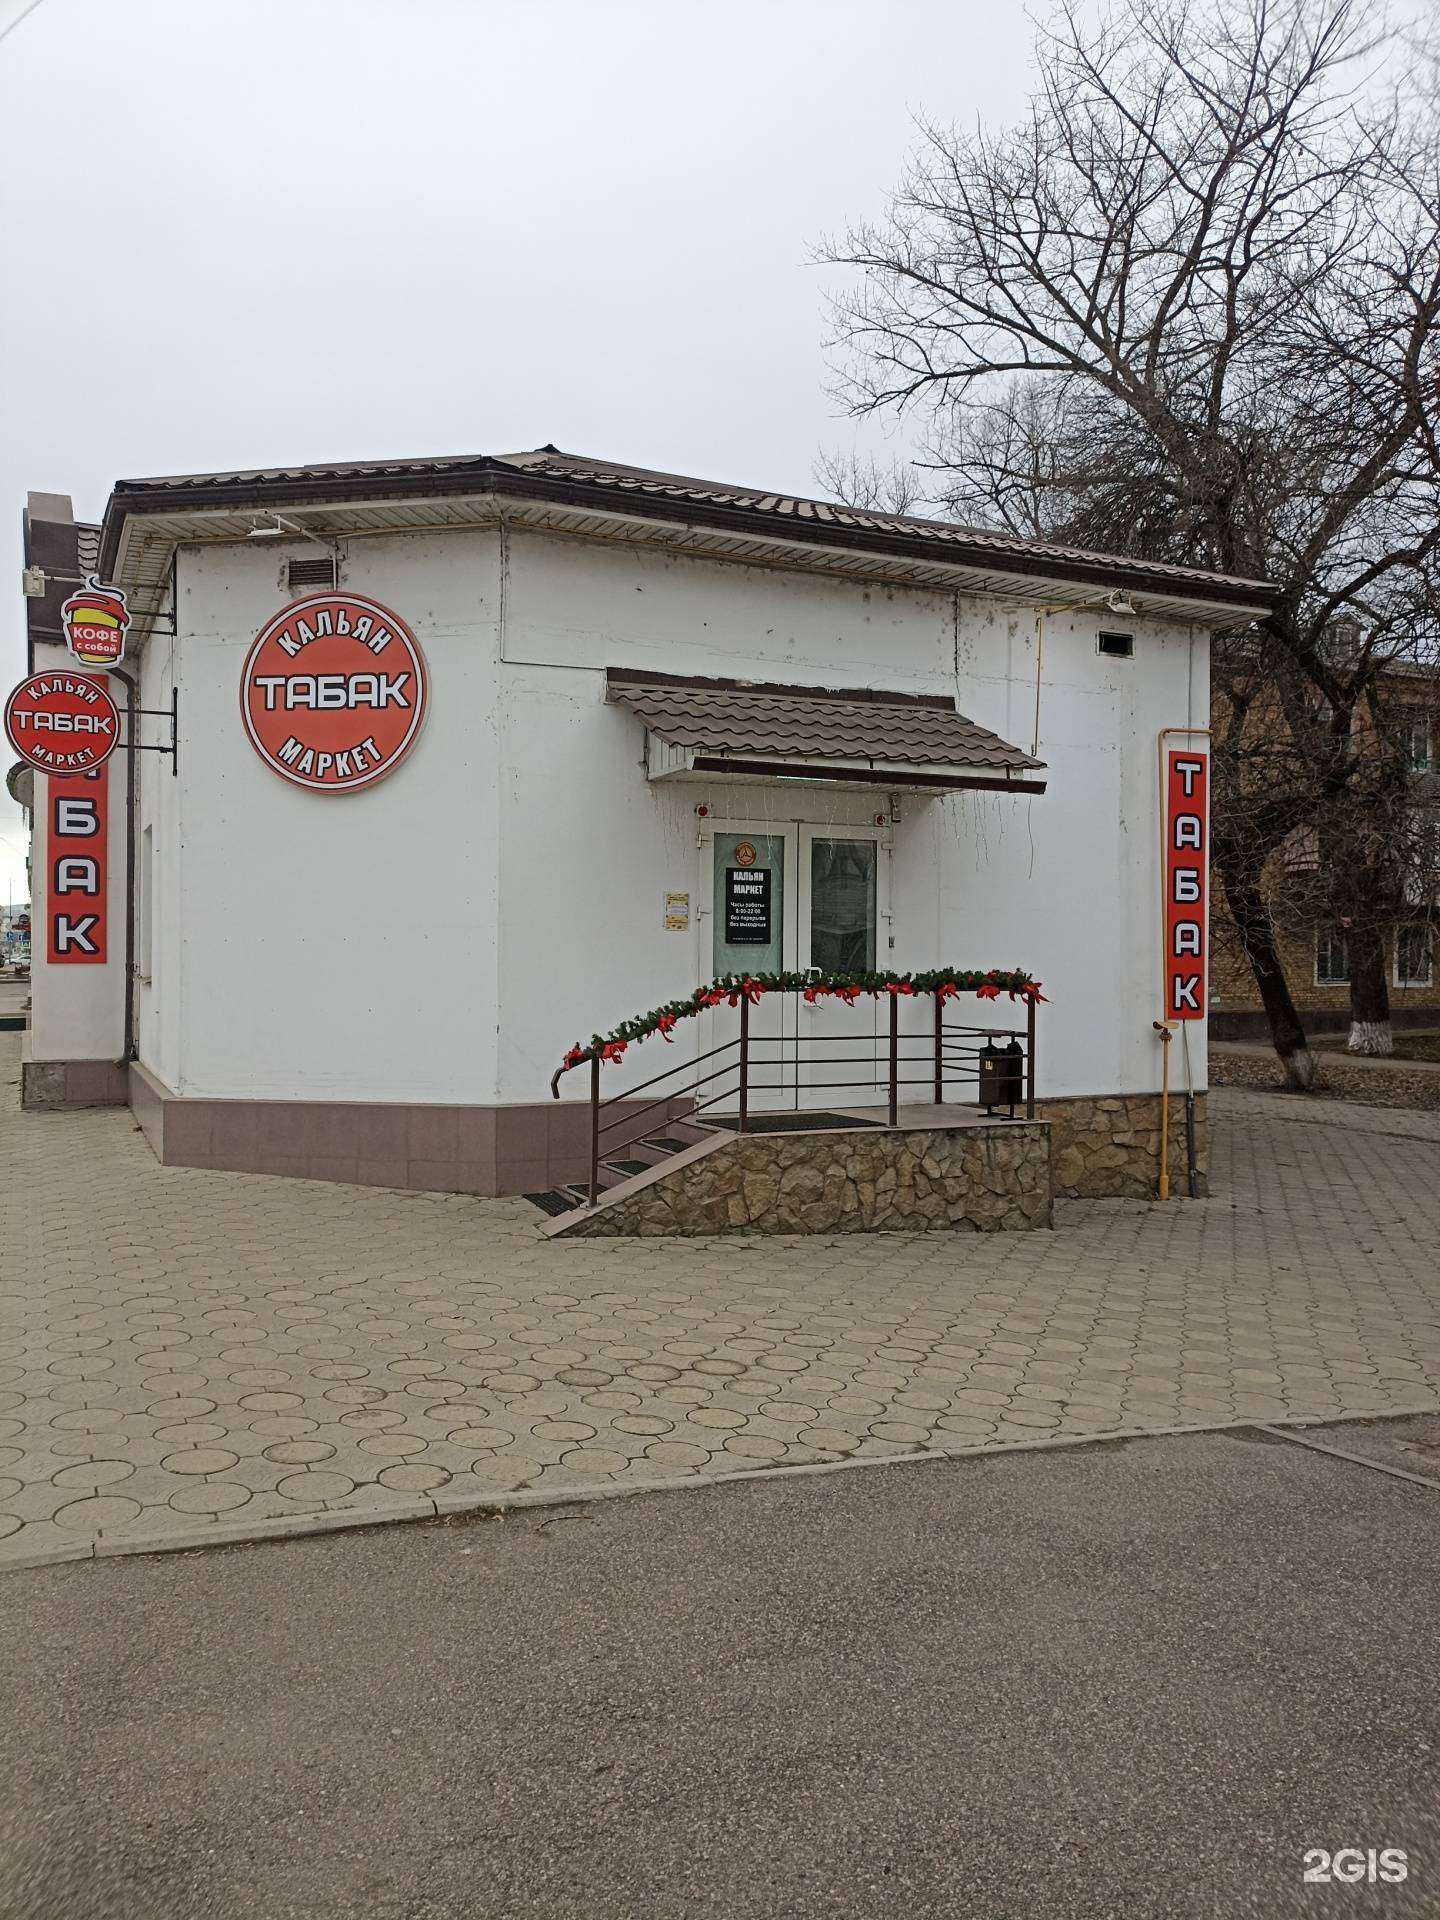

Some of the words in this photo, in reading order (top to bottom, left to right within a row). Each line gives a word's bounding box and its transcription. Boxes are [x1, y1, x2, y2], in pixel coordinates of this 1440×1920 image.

[73, 626, 118, 642] КОФЕ
[277, 609, 393, 658] КАЛЬЯН
[84, 642, 117, 652] собой
[27, 679, 99, 704] КАЛЬЯН
[254, 672, 411, 710] ТАБАК
[13, 710, 112, 735] ТАБАК
[31, 743, 95, 766] МАРКЕТ
[277, 736, 382, 777] МАРКЕТ
[56, 768, 98, 952] БАК
[733, 871, 764, 881] КАЛЬЯН
[1174, 761, 1202, 1009] ТАБАК
[733, 884, 764, 895] МАРКЕТ
